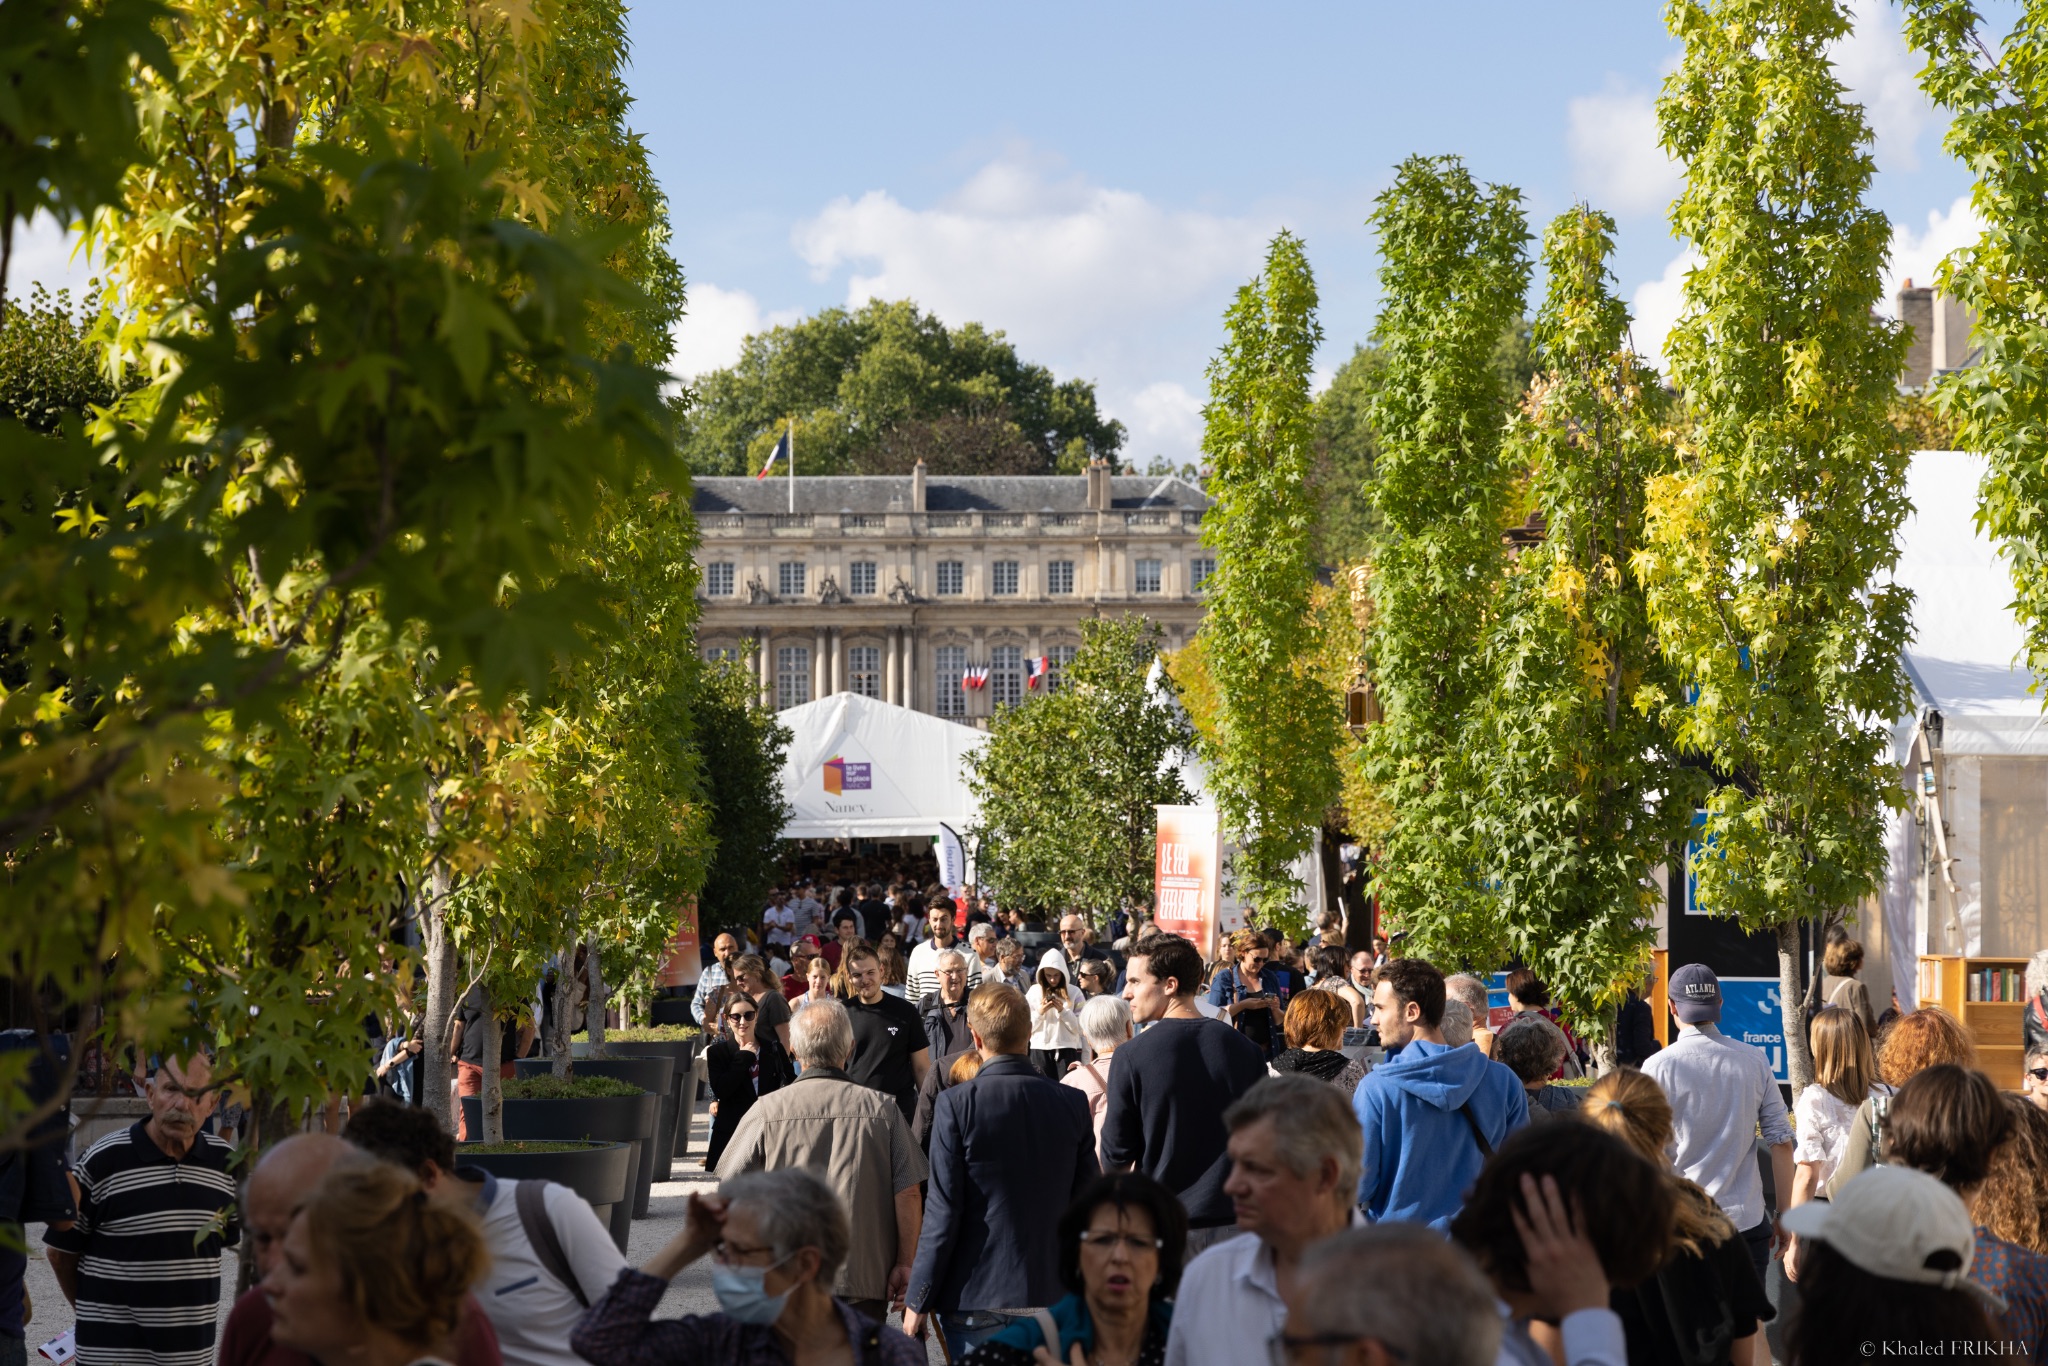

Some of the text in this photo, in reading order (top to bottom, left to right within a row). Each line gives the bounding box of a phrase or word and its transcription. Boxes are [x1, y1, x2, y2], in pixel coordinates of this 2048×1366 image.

[853, 775, 870, 783] place
[1161, 843, 1188, 875] LE FEU
[1685, 983, 1716, 994] ATLANTA
[1743, 1031, 1781, 1043] france
